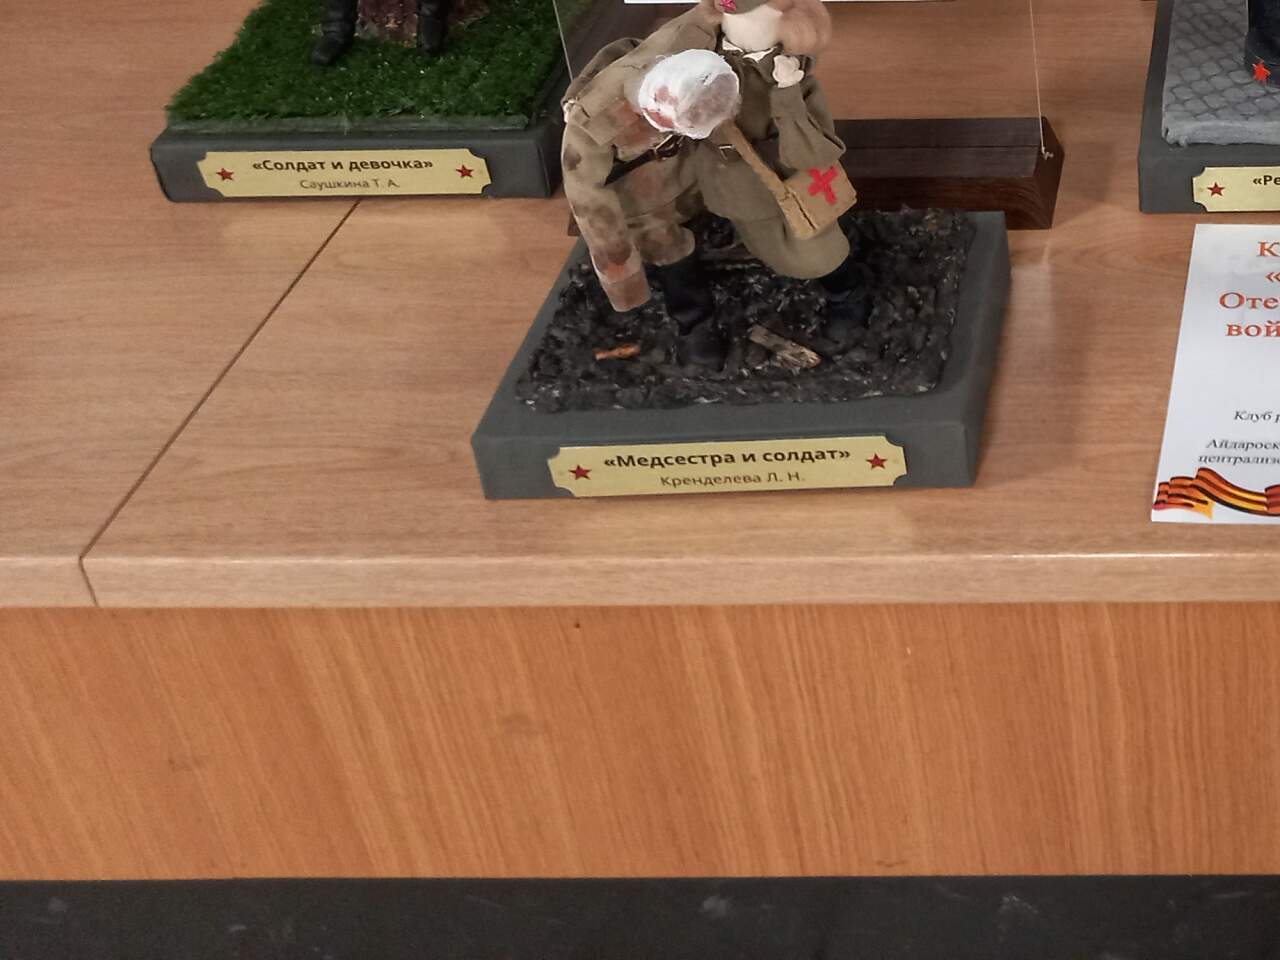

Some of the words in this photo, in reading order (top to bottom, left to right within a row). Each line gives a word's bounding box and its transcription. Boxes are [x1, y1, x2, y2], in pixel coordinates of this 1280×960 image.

[252, 159, 325, 173] «Солдат
[331, 161, 344, 170] и
[349, 159, 434, 172] девочка»
[300, 178, 370, 191] Саушкина
[372, 178, 385, 188] Т.
[1233, 410, 1273, 423] Клуб
[603, 451, 737, 469] «Медсестра
[742, 453, 757, 464] и
[762, 447, 852, 464] солдат»
[660, 471, 763, 487] Кренделева
[766, 472, 783, 483] Л.
[787, 470, 806, 482] Н.
